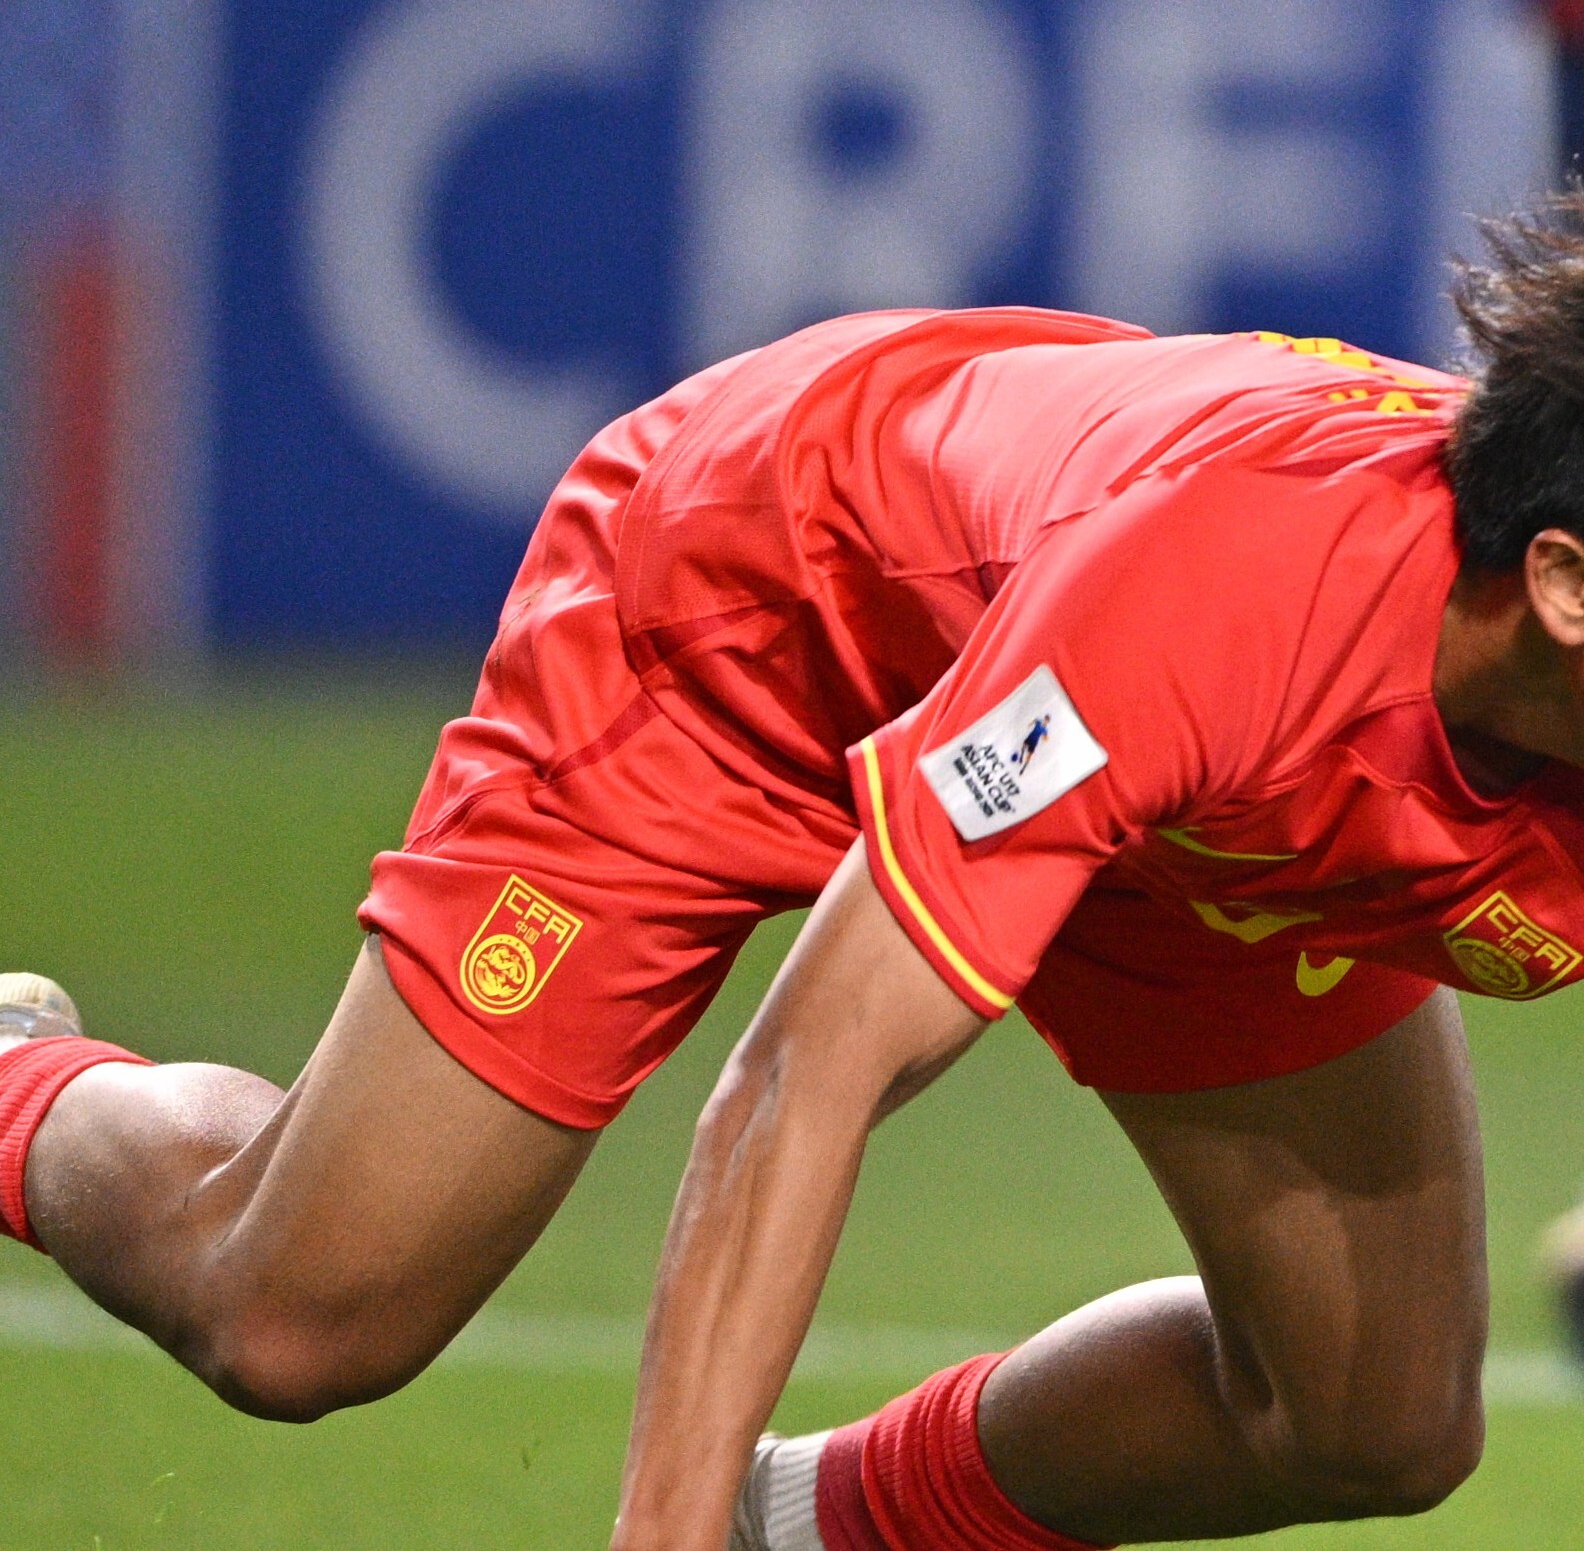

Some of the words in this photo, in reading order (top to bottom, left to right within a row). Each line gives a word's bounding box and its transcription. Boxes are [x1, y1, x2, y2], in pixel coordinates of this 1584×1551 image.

[961, 744, 992, 787] ASIAN
[988, 785, 1012, 814] CUP
[505, 887, 571, 944] CFA
[514, 920, 541, 945] 中国
[1486, 904, 1568, 971] CFA
